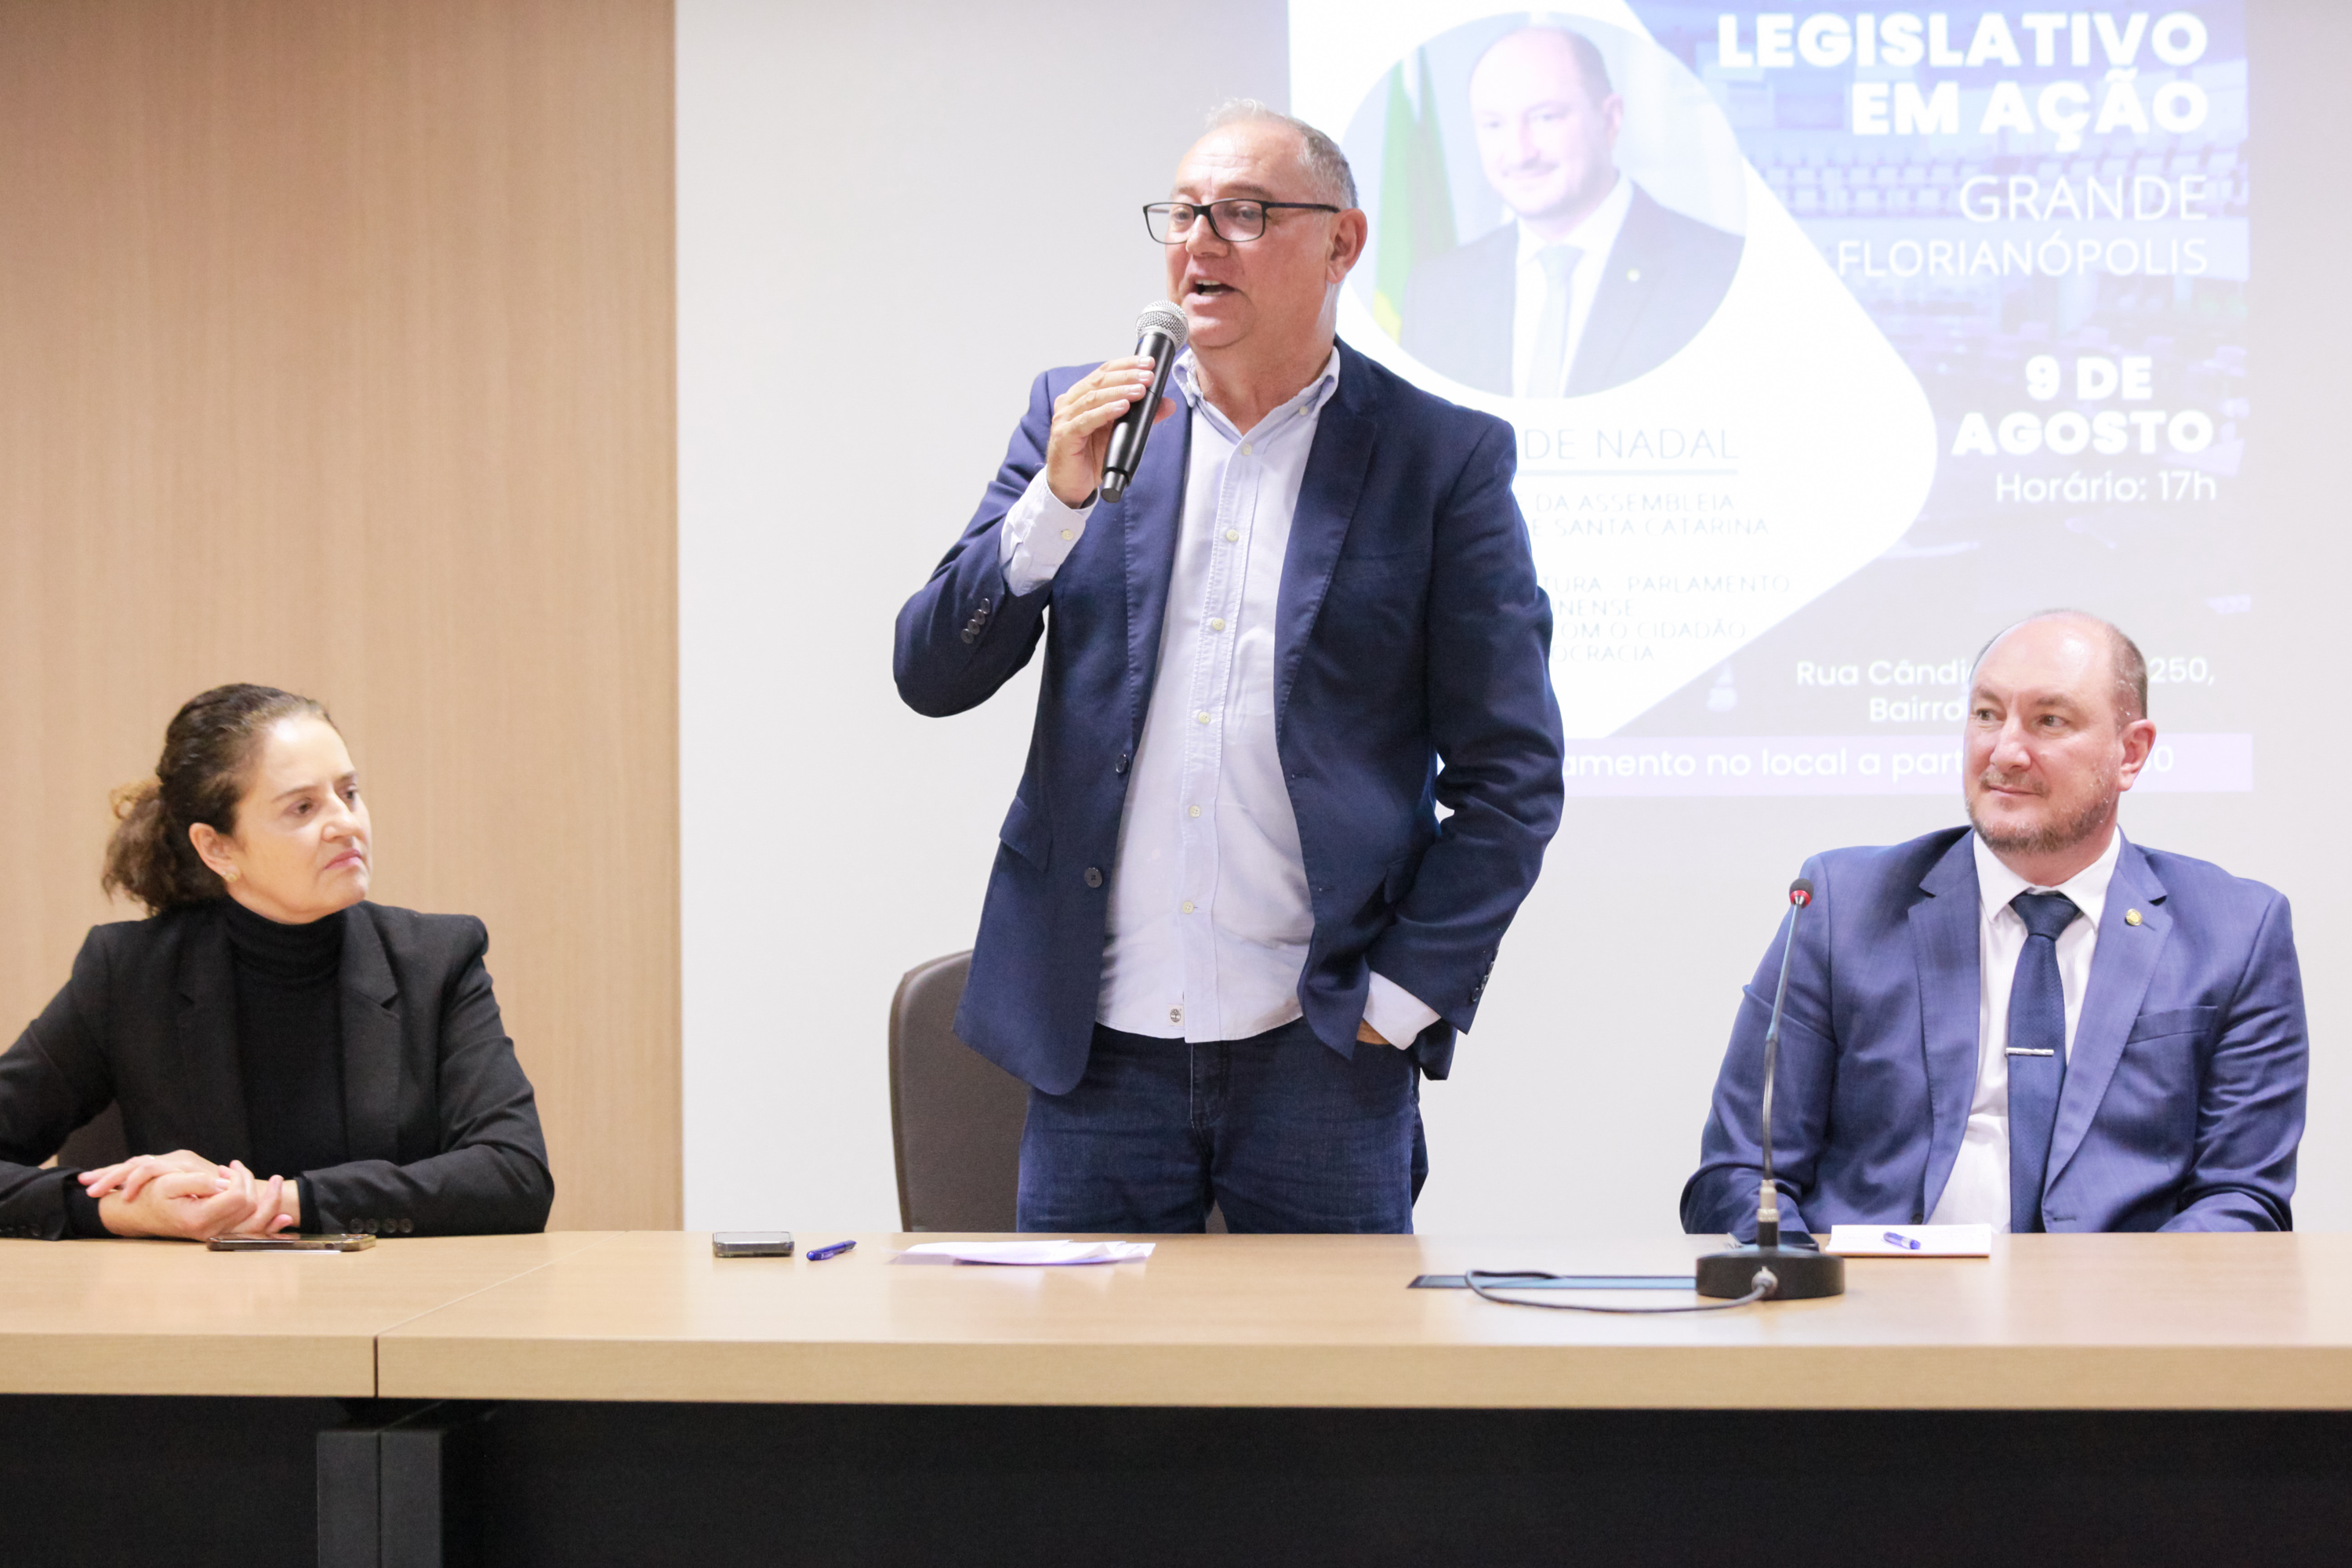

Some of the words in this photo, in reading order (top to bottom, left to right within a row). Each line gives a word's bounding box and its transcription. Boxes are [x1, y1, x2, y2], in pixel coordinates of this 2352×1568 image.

[1718, 13, 2209, 67] LEGISLATIVO
[1851, 81, 1960, 136] EM
[1979, 67, 2209, 152] AÇÃO
[1959, 174, 2208, 223] GRANDE
[1837, 230, 2208, 278] FLORIANÓPOLIS
[2025, 354, 2061, 401] 9
[2076, 355, 2153, 401] DE
[1523, 427, 1577, 460] DE
[1596, 427, 1740, 460] NADAL
[1951, 408, 2215, 456] AGOSTO
[1536, 493, 1570, 513] DA
[1579, 492, 1735, 513] ASSEMBLEIA
[1995, 470, 2147, 503] Horário:
[2159, 470, 2217, 502] 17h
[1555, 517, 1635, 537] SANTA
[1645, 516, 1769, 536] CATARINA
[1628, 574, 1791, 593] PARLAMENTO
[1557, 621, 1601, 641] OM
[1610, 621, 1628, 640] O
[1637, 618, 1747, 640] CIDADÃO
[1796, 659, 1860, 687] Rua
[1707, 753, 1752, 777] no
[1762, 746, 1847, 776] local
[1857, 752, 1881, 776] a
